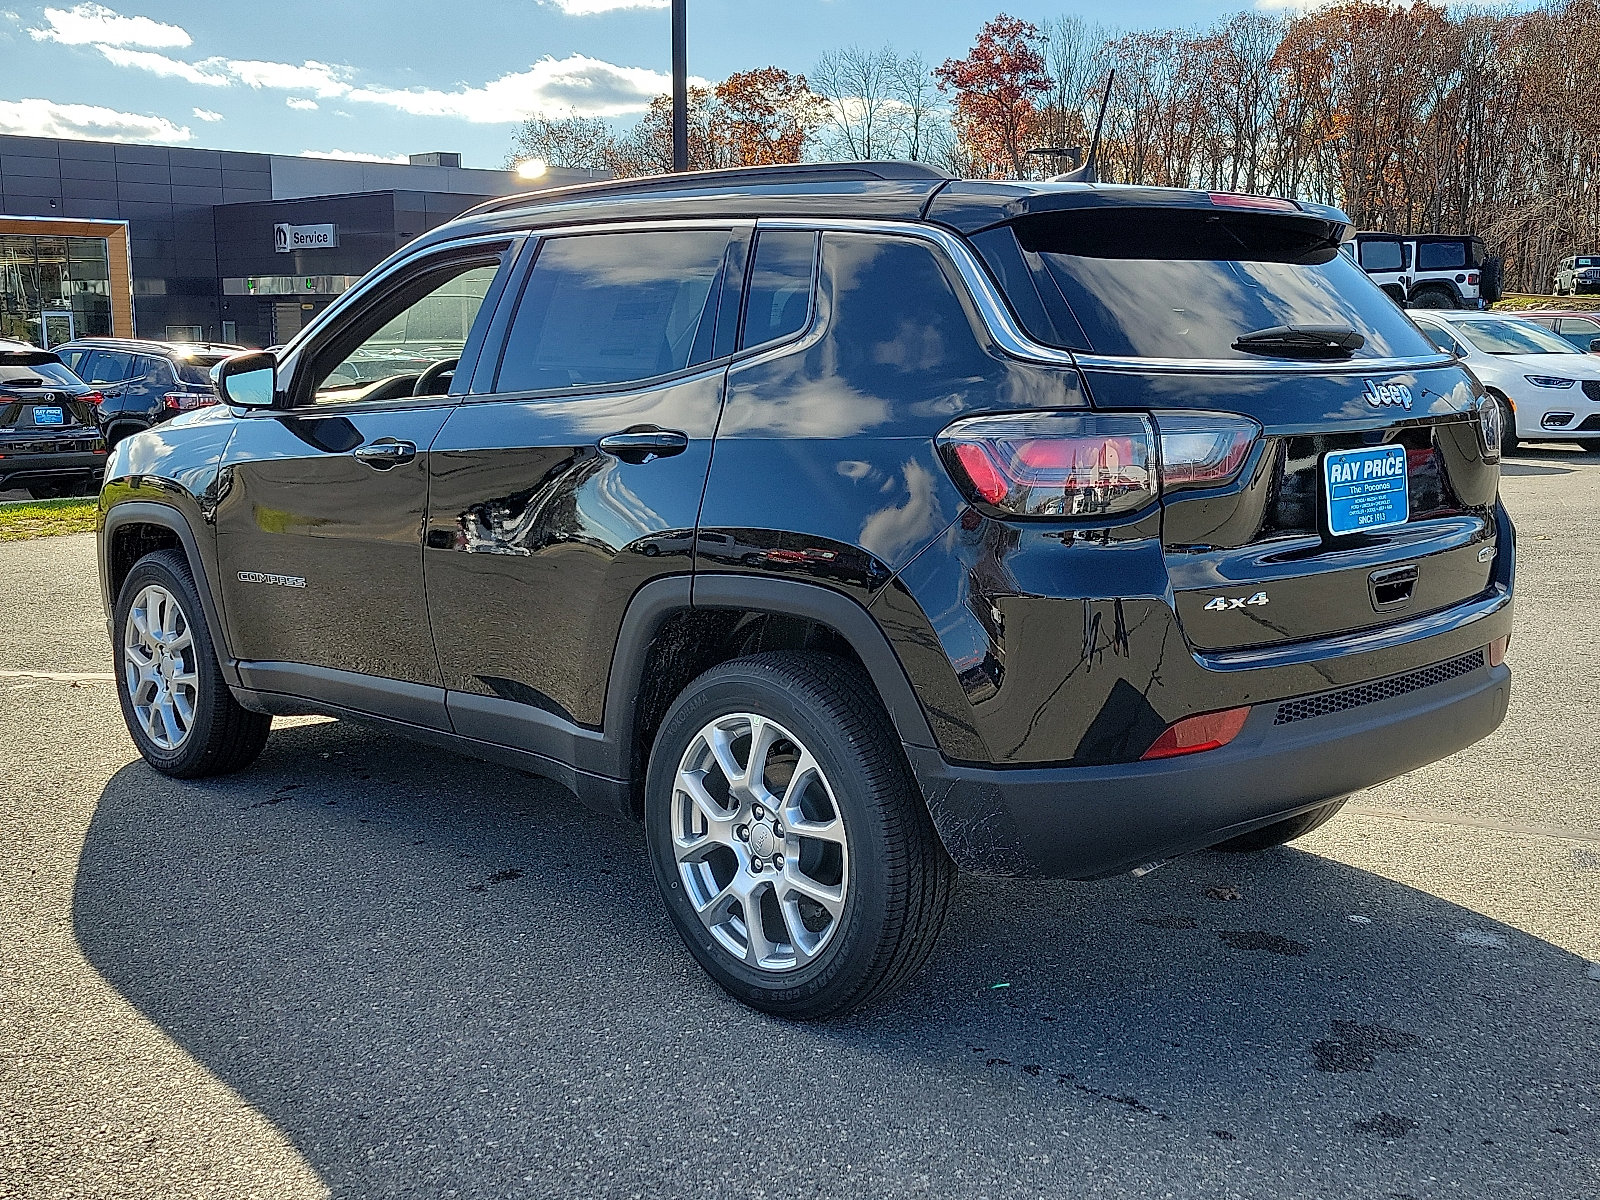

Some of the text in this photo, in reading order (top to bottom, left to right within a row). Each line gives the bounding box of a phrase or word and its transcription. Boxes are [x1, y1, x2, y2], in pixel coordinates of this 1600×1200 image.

[293, 231, 328, 244] Service
[1363, 379, 1412, 411] Jeep
[1331, 457, 1403, 483] RAY PRICE
[1349, 482, 1391, 494] The Poconos
[1358, 512, 1386, 525] SINCE 1913
[237, 571, 306, 588] COMPASS
[1204, 591, 1270, 611] 4x4
